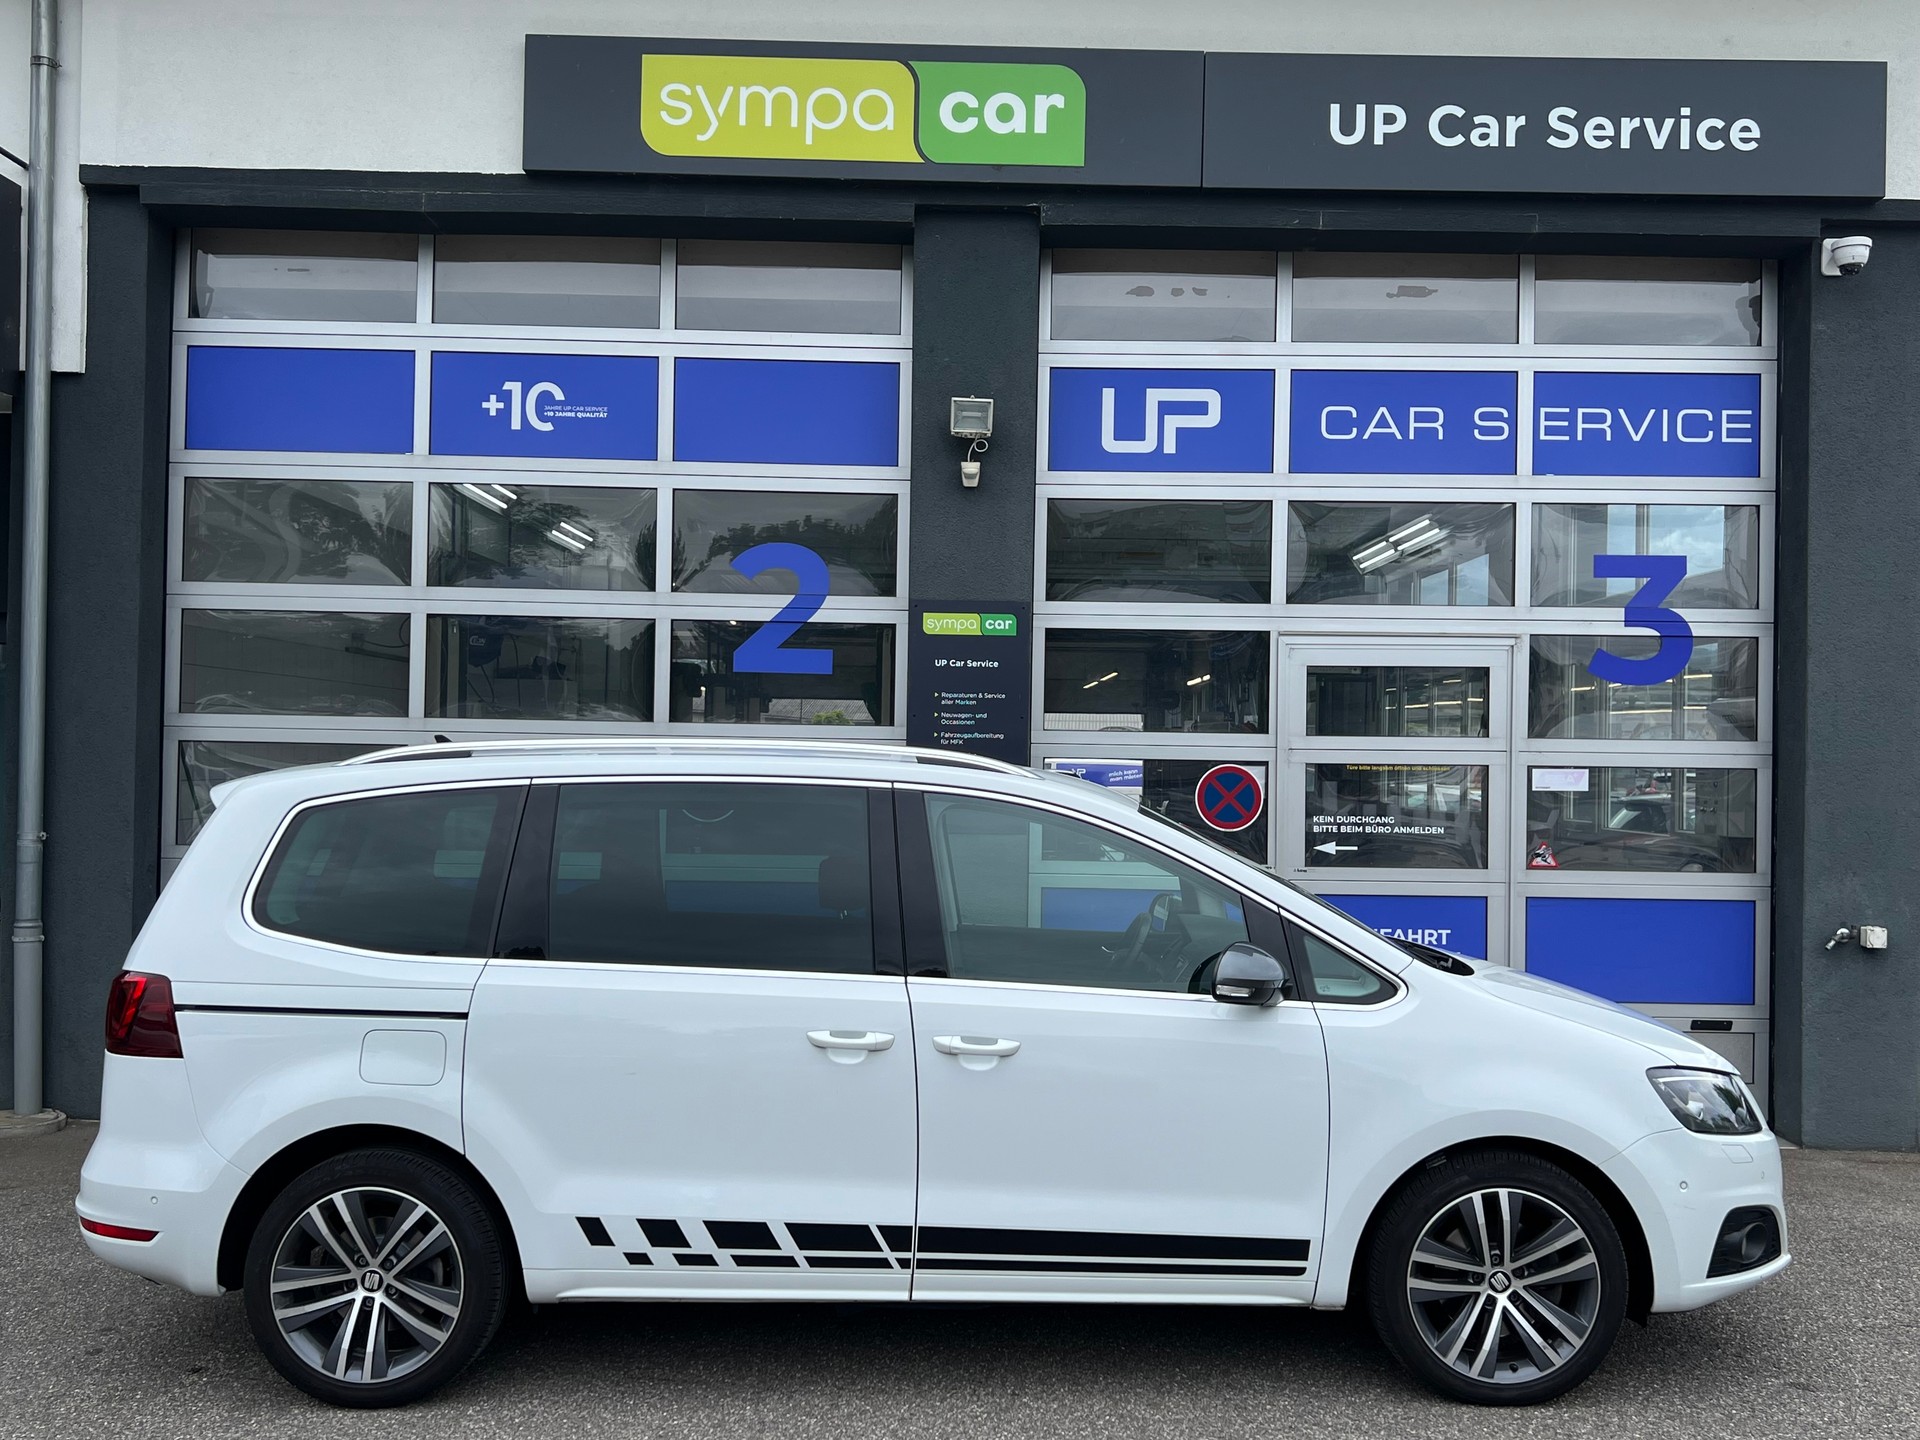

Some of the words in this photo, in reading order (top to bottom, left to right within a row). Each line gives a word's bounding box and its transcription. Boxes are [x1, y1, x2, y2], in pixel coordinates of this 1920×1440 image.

[659, 81, 894, 145] sympa
[938, 90, 1065, 134] car
[1329, 103, 1406, 145] UP
[1428, 105, 1526, 148] Car
[1546, 106, 1761, 152] Service
[1101, 388, 1220, 454] UP
[1320, 405, 1445, 441] CAR
[1474, 407, 1753, 444] SERVICE
[730, 541, 833, 675] 2
[927, 618, 976, 632] sympa
[985, 619, 1013, 630] car
[1588, 555, 1694, 686] 3
[934, 659, 947, 667] UP
[949, 659, 964, 667] Car
[966, 660, 999, 668] Service
[1313, 815, 1334, 823] KEIN
[1336, 816, 1395, 824] DURCHGANG
[1313, 825, 1338, 833] BITTE
[1365, 825, 1391, 834] BÜRO
[1393, 826, 1445, 834] ANMELDEN
